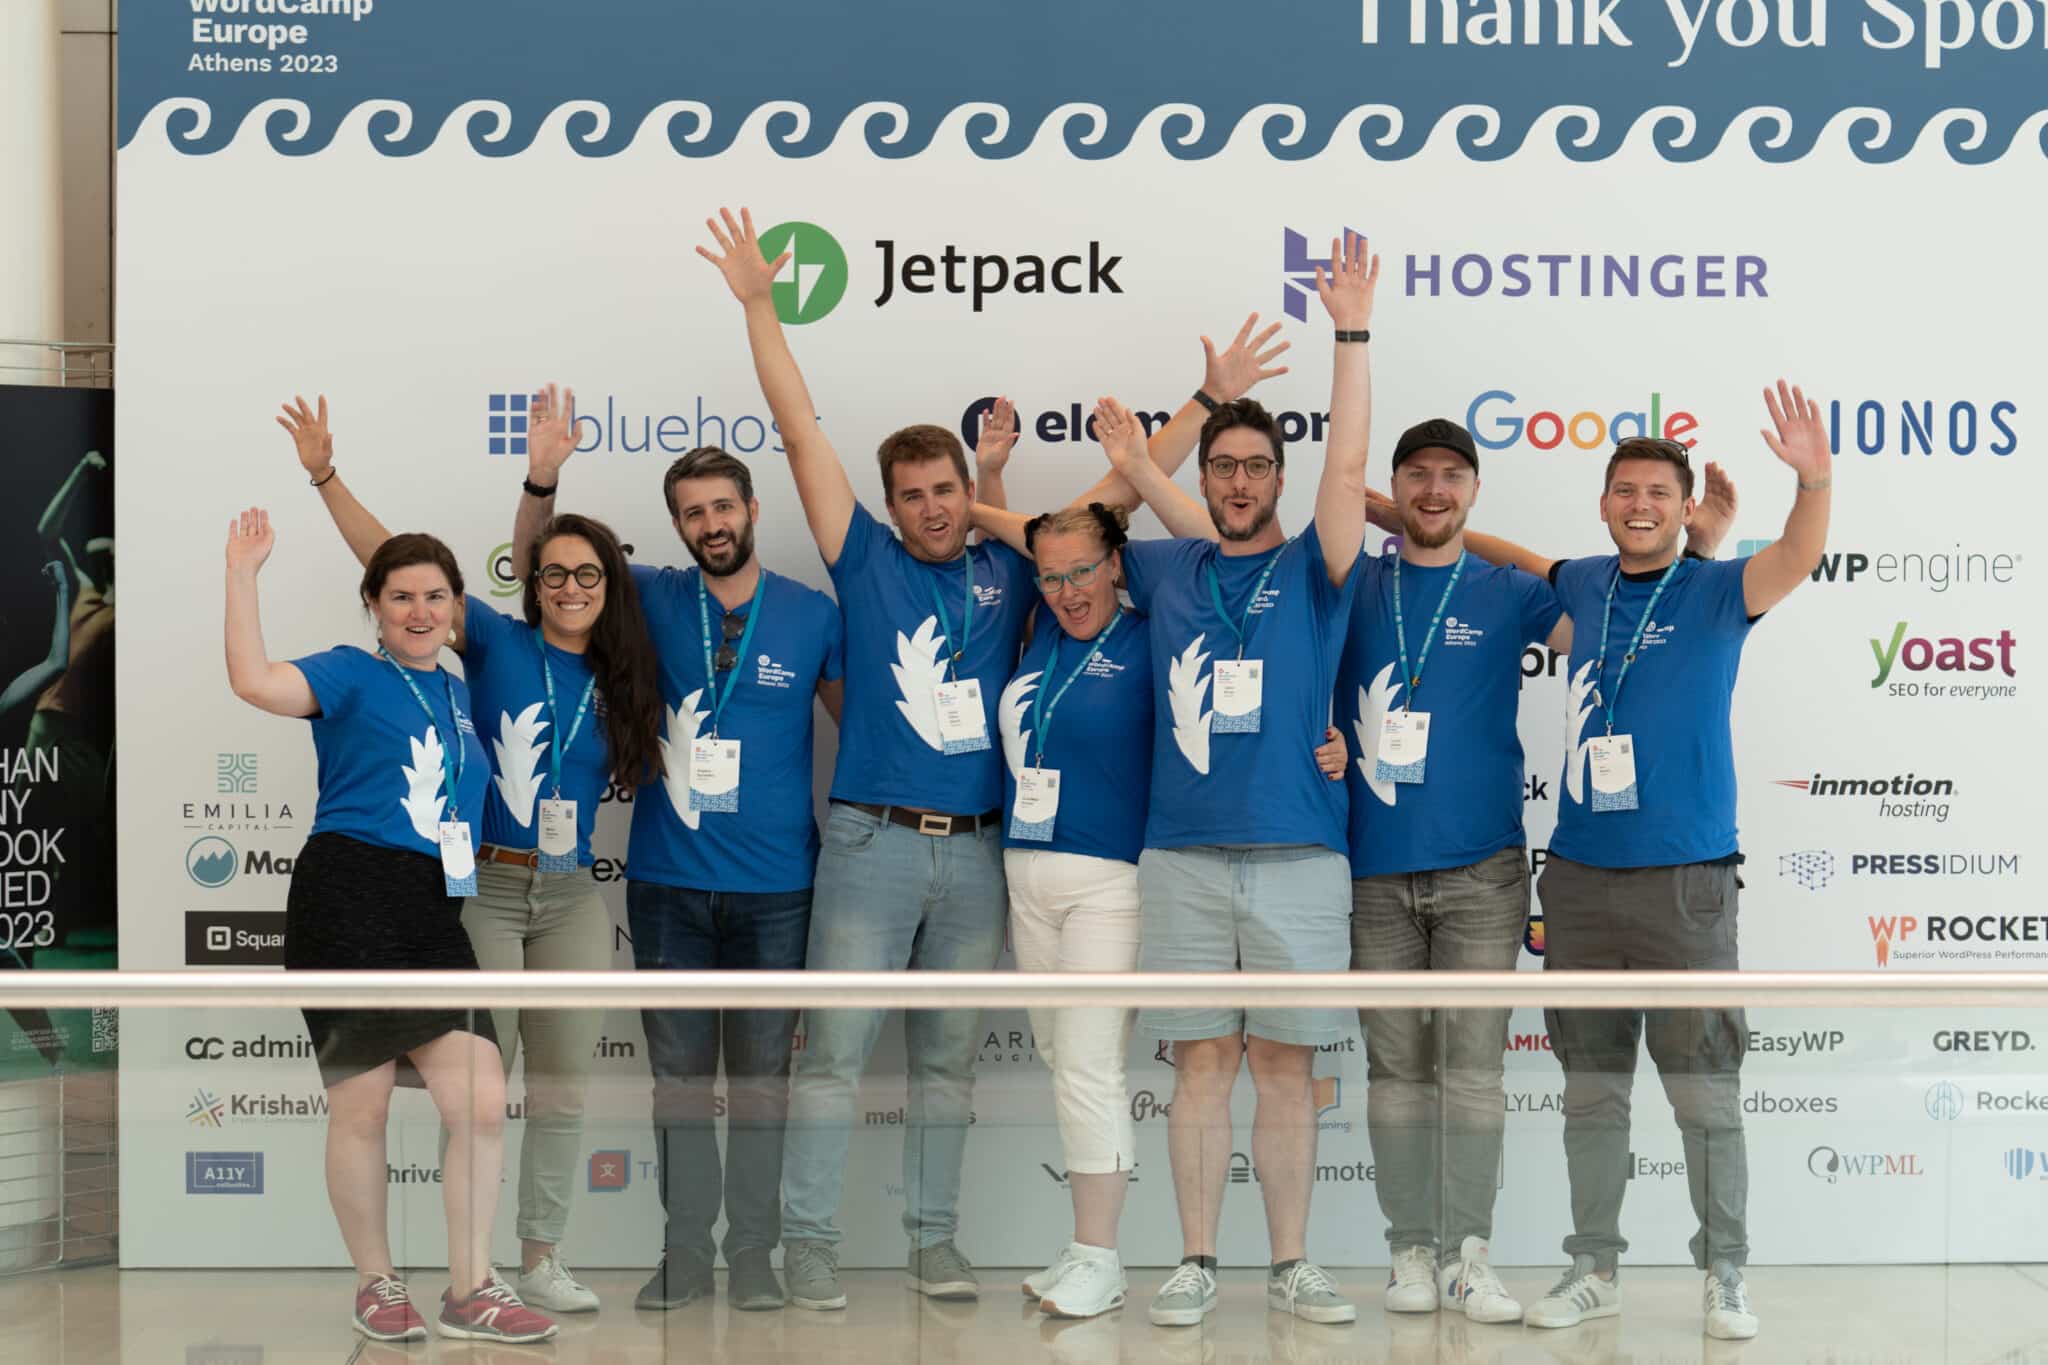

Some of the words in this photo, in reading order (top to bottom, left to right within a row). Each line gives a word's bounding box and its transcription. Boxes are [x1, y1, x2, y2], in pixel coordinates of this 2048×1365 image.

[192, 18, 308, 50] Europe
[1666, 0, 1826, 67] you
[188, 53, 272, 72] Athens
[279, 54, 338, 73] 2023
[874, 239, 1124, 312] Jetpack
[1405, 253, 1769, 297] HOSTINGER
[570, 396, 821, 452] blueho
[1830, 399, 2018, 456] IONOS
[1869, 621, 2017, 689] yoast
[1888, 683, 1919, 697] SEO
[1923, 682, 1947, 697] for
[1949, 685, 2017, 701] everyone
[1810, 773, 1954, 796] inmotion
[183, 803, 293, 819] EMILIA
[1879, 798, 1950, 823] hosting
[208, 823, 269, 831] CAPITAL
[1851, 854, 2019, 875] PRESSIDIUM
[1868, 915, 1917, 942] WP
[1892, 950, 1936, 961] Superior
[1938, 950, 1993, 960] WordPress
[1994, 950, 2048, 960] Performan
[1747, 1030, 1845, 1057] EasyWP
[1932, 1030, 2036, 1052] GREYD.
[204, 1166, 246, 1181] A11Y
[386, 1163, 444, 1184] hrive
[1637, 1157, 1686, 1180] Expe
[1842, 1154, 1925, 1176] WPML
